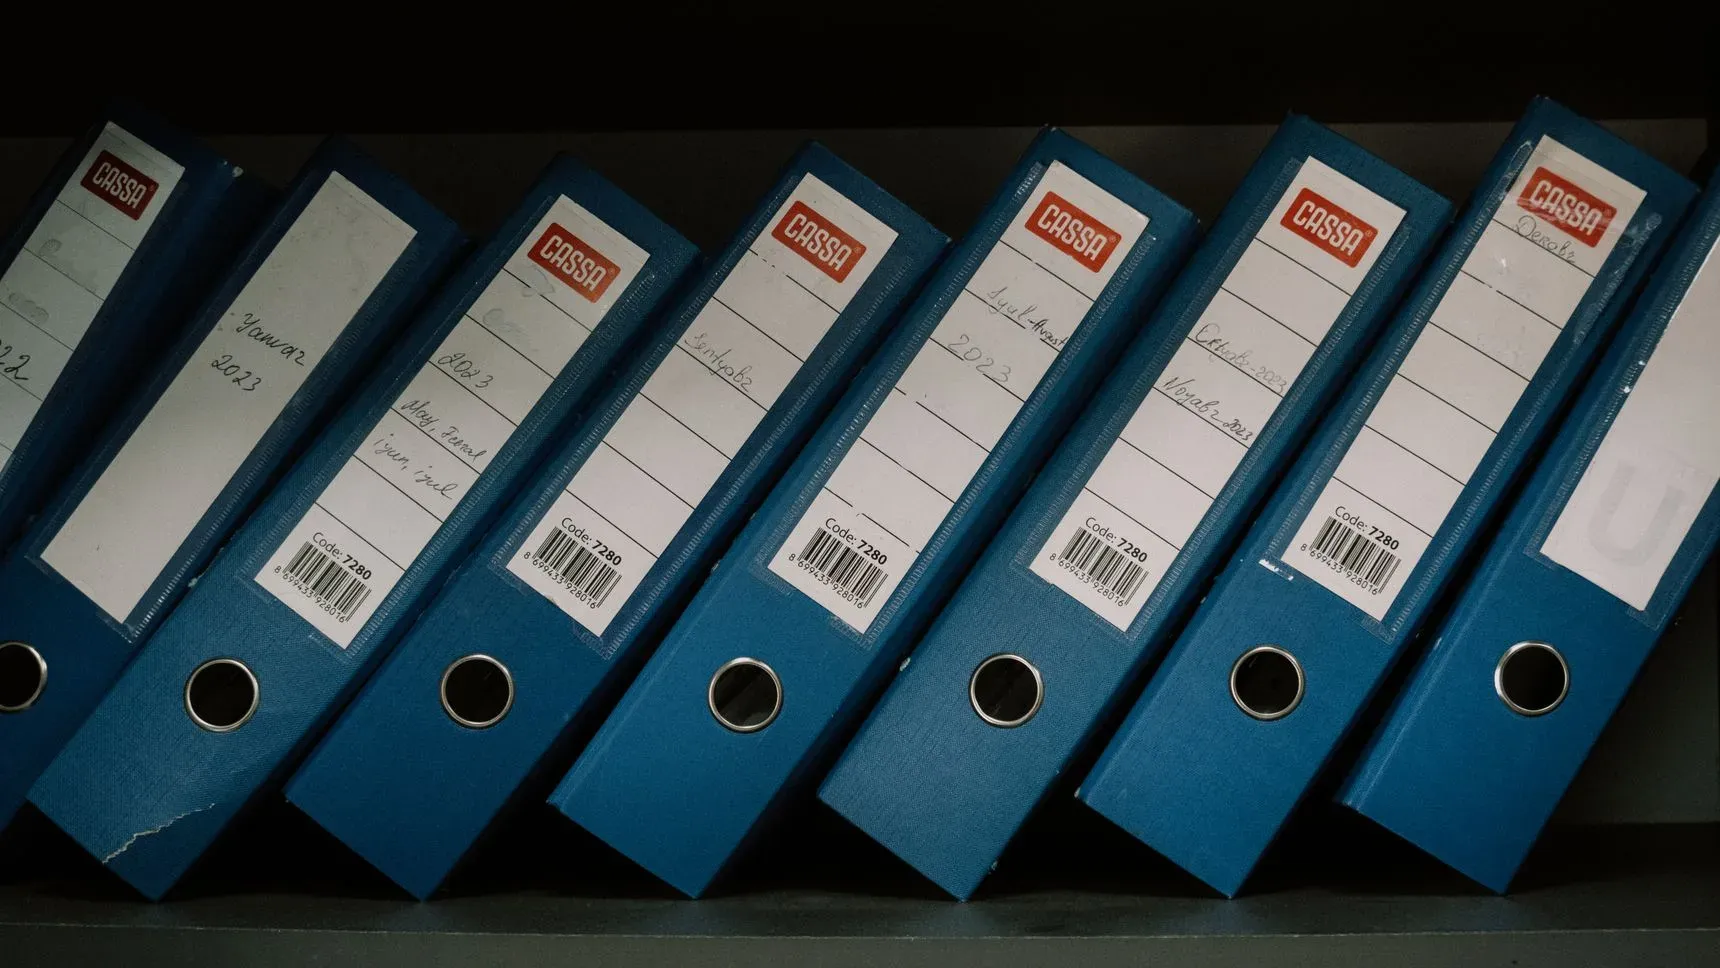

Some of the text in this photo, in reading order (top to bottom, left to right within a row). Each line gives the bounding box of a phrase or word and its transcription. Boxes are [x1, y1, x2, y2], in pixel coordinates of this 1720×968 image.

[92, 161, 148, 208] CASSA
[1528, 180, 1603, 236] CASSA
[784, 213, 852, 271] CASSA
[1037, 204, 1108, 261] CASSA
[1293, 200, 1364, 257] CASSA
[540, 234, 607, 292] CASSA
[211, 354, 262, 391] 2023
[437, 352, 494, 389] 2023
[948, 334, 1011, 383] 2023
[561, 517, 622, 566] Code: 7280
[825, 518, 888, 565] Code: 7280
[1085, 517, 1148, 563] Code: 7280
[1335, 506, 1400, 550] Code: 7280
[313, 532, 372, 580] Code: 7280
[523, 551, 531, 559] 8
[566, 582, 596, 609] 928016
[788, 553, 796, 561] 8
[832, 583, 863, 609] 928016
[1049, 553, 1057, 561] 8
[1093, 581, 1124, 607] 928016
[1300, 543, 1308, 552] 8
[1346, 571, 1378, 596] 928016
[274, 565, 282, 573] 8
[315, 596, 346, 623] 928016
